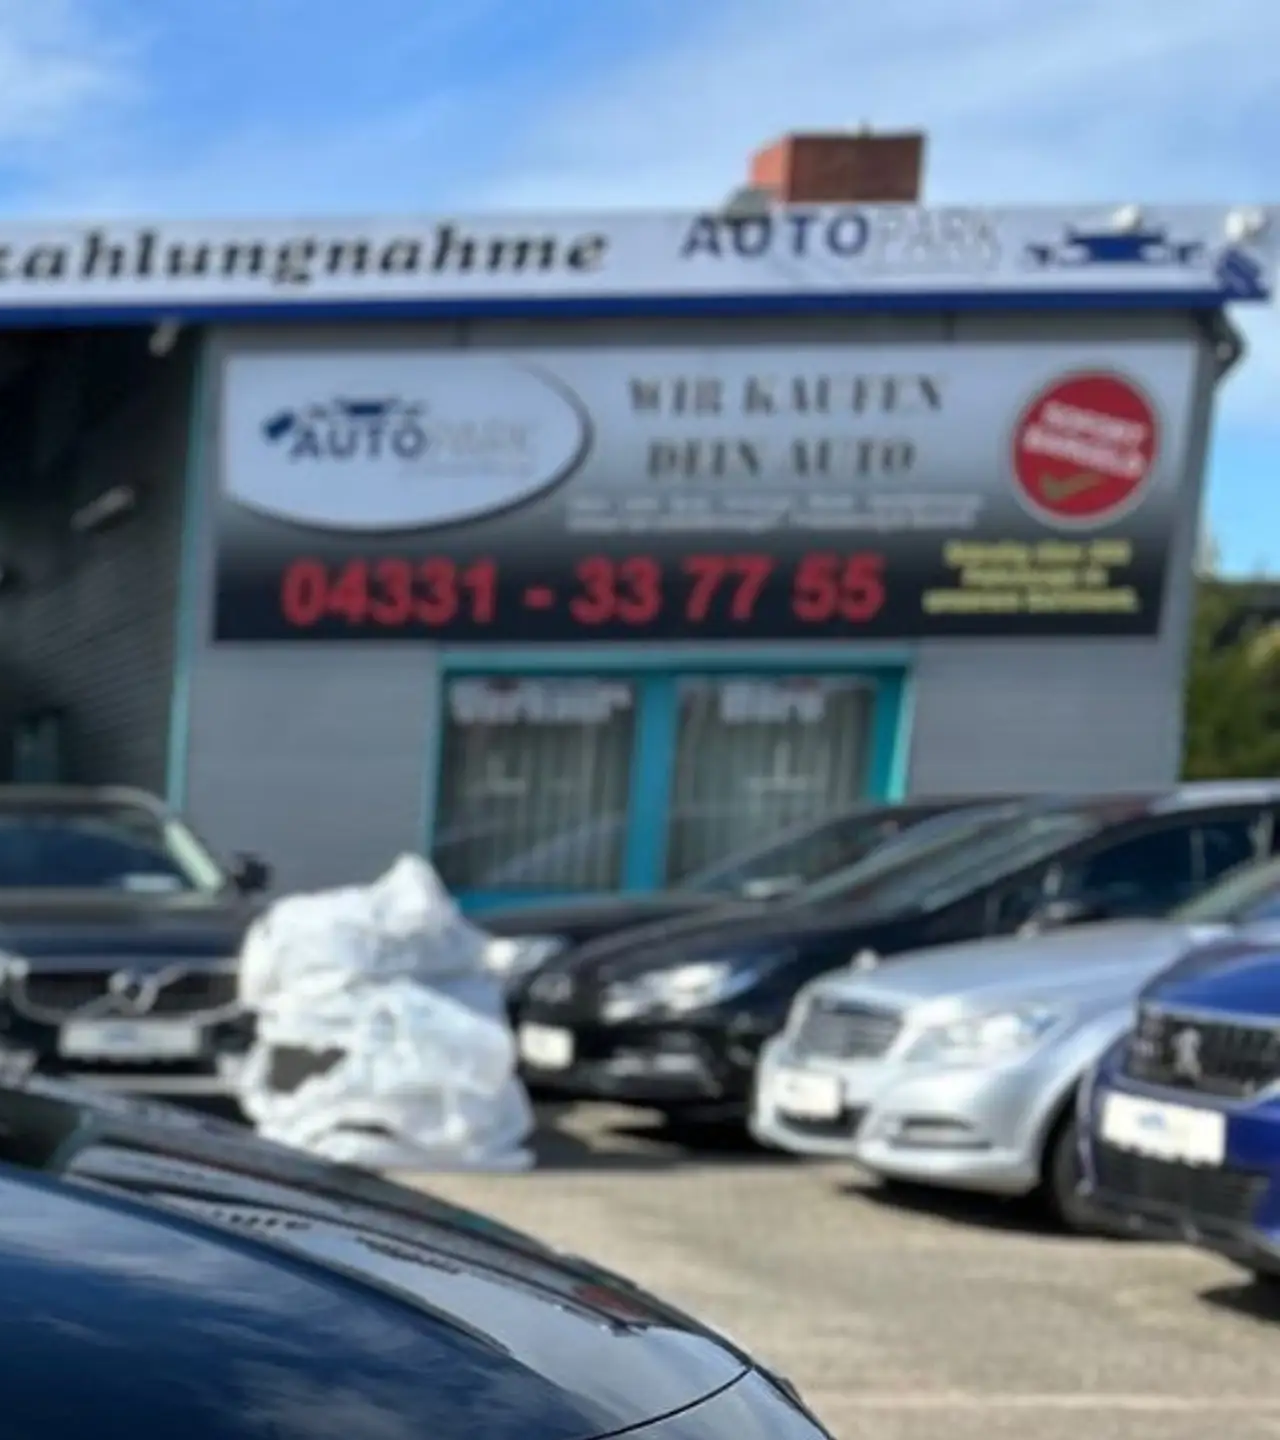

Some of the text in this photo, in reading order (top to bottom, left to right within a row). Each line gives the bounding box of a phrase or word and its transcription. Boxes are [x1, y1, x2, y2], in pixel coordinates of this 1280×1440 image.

[628, 371, 948, 418] WIR KAUFEN
[646, 435, 918, 478] DEIN AUTO
[281, 556, 497, 626] 04331
[570, 553, 661, 624] 33
[683, 552, 776, 622] 77
[791, 550, 887, 622] 55
